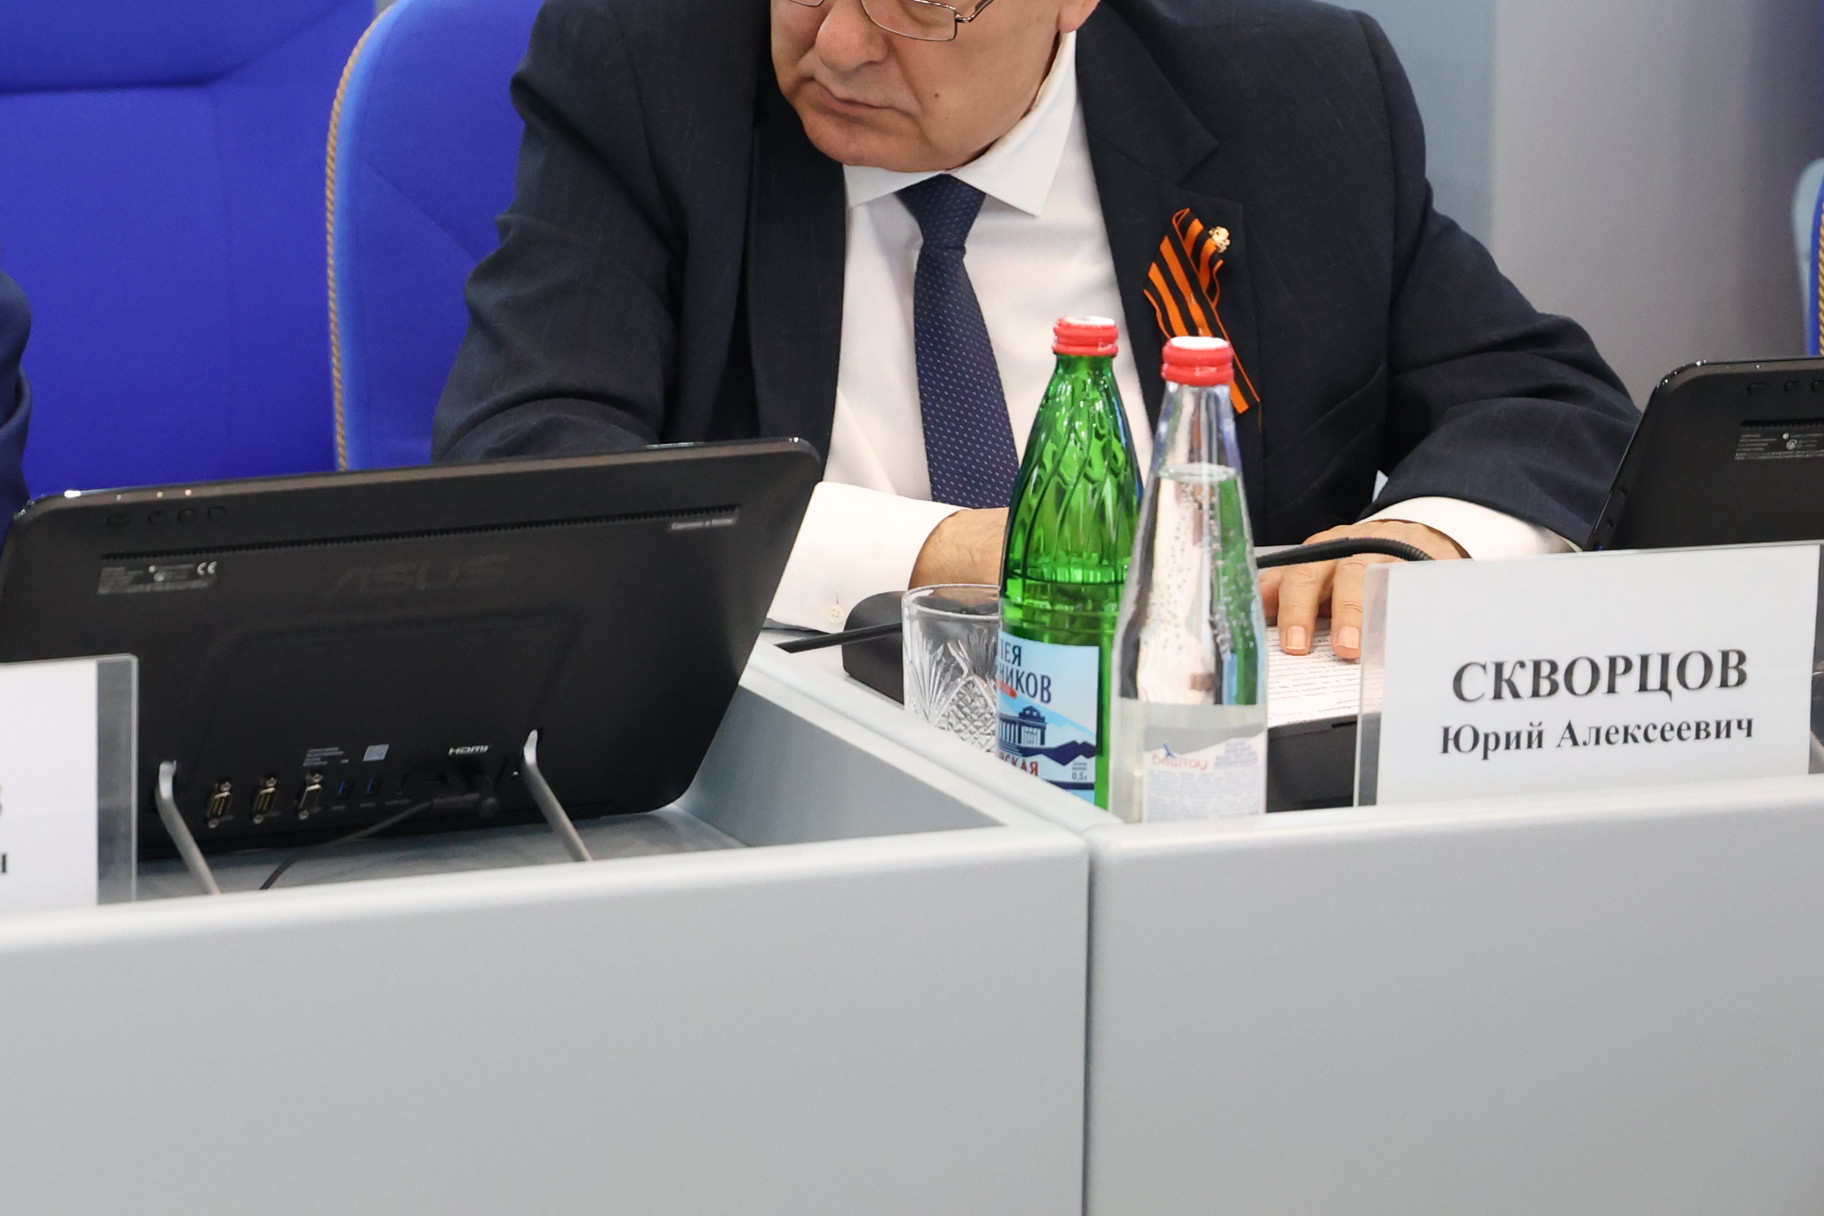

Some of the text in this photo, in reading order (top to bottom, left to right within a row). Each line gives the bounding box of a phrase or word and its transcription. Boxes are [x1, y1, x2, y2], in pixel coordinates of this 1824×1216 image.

[331, 556, 510, 595] ASUS
[1452, 649, 1748, 703] СКВОРЦОВ
[1440, 718, 1755, 761] Юрий Алексеевич
